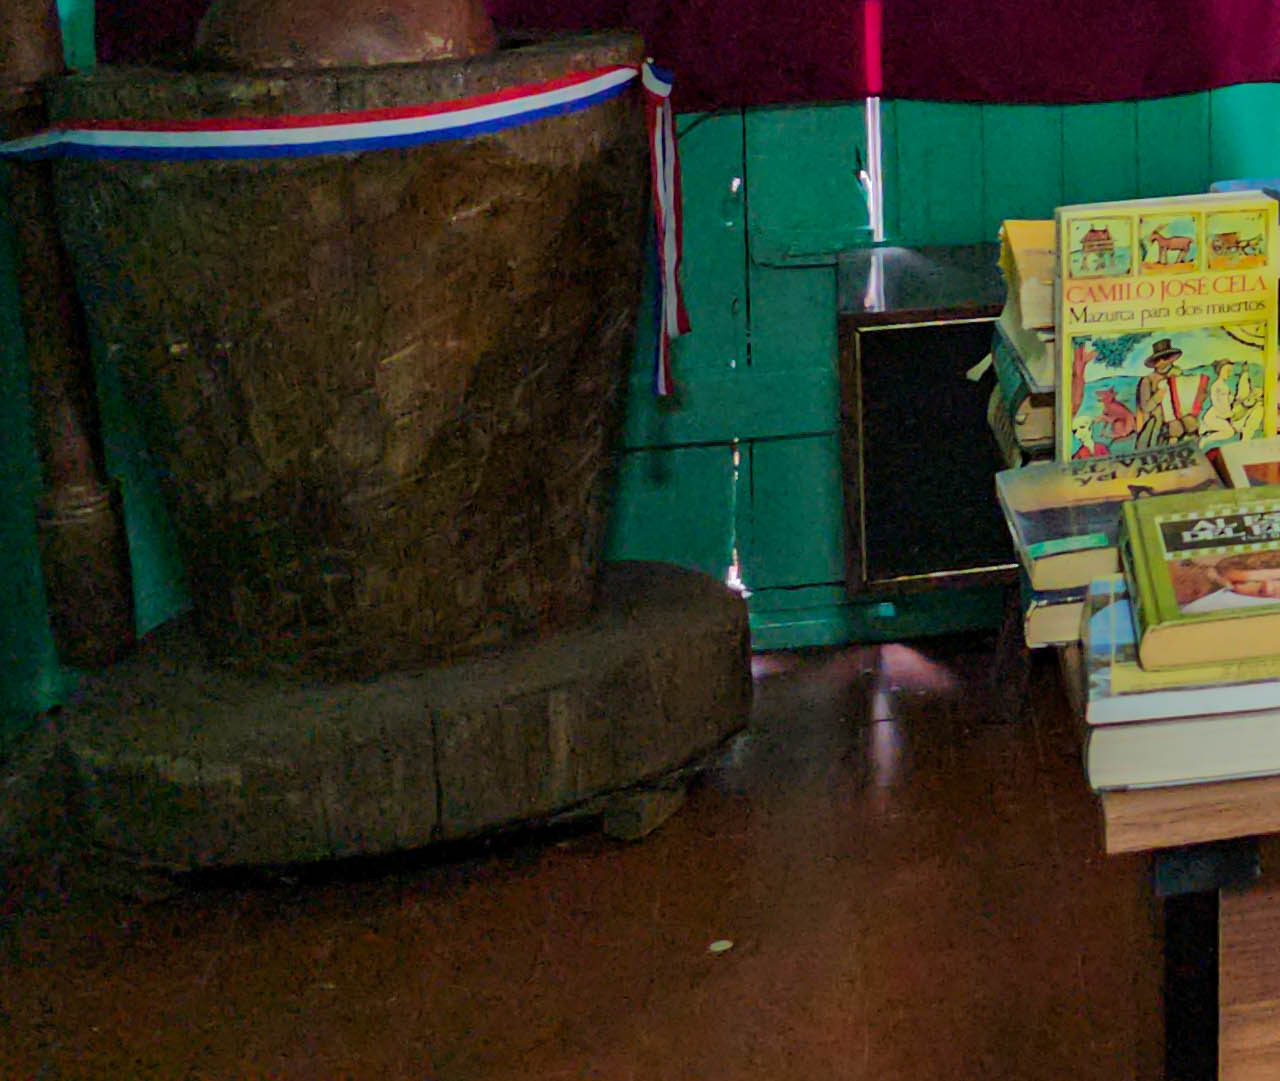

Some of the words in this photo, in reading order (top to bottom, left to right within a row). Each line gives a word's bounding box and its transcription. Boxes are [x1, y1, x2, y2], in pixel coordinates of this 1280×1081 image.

[1066, 280, 1155, 304] CAMILO
[1212, 275, 1269, 295] CELA
[1140, 306, 1170, 328] para
[1175, 300, 1201, 318] dos
[1206, 299, 1266, 315] muertos
[1192, 518, 1238, 534] AL
